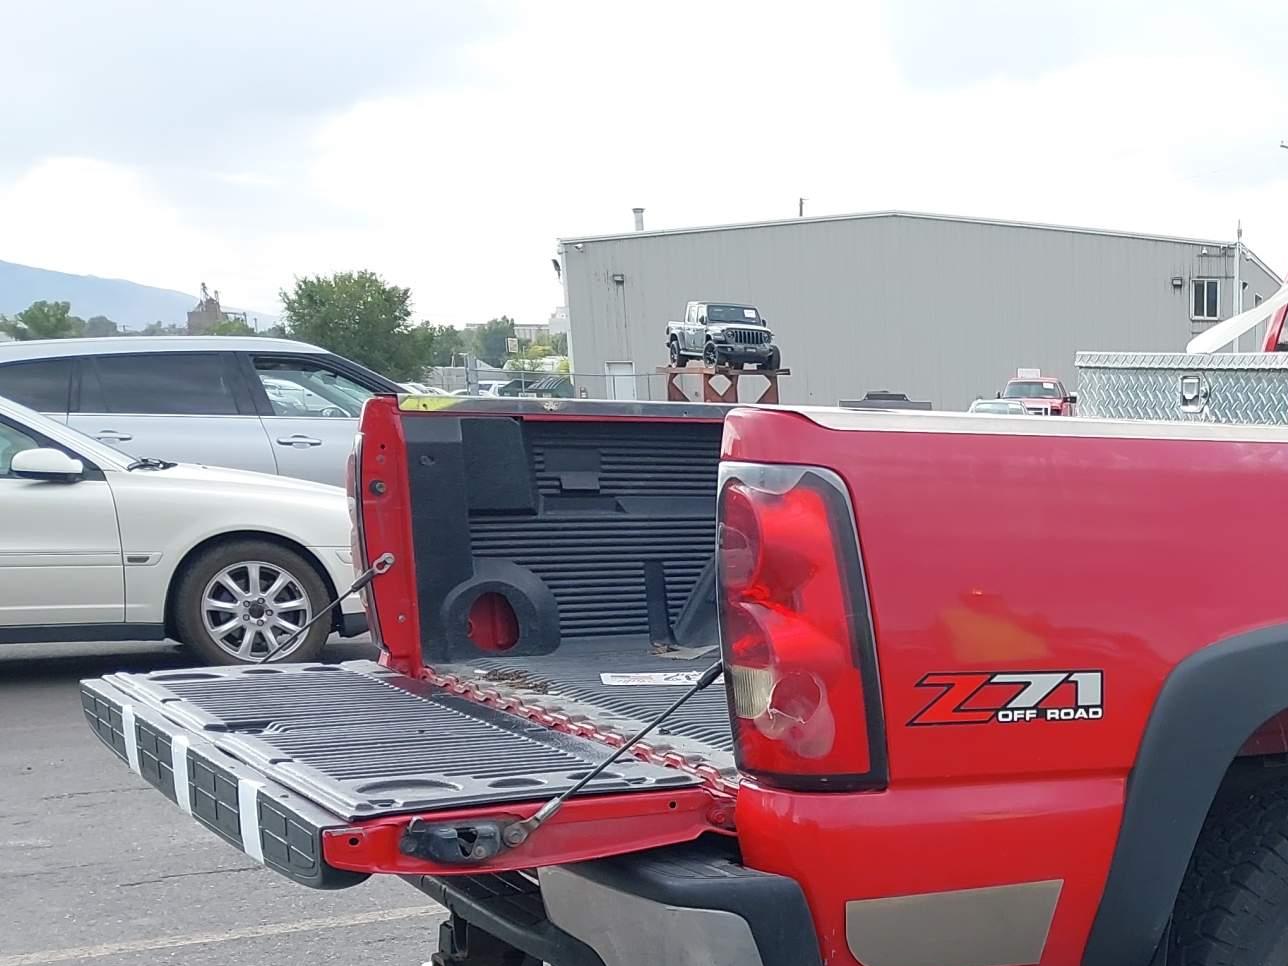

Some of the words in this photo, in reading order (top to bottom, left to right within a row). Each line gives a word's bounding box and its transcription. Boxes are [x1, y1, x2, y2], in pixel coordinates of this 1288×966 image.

[906, 670, 1104, 726] Z71
[997, 709, 1038, 723] OFF
[1046, 707, 1103, 721] ROAD
